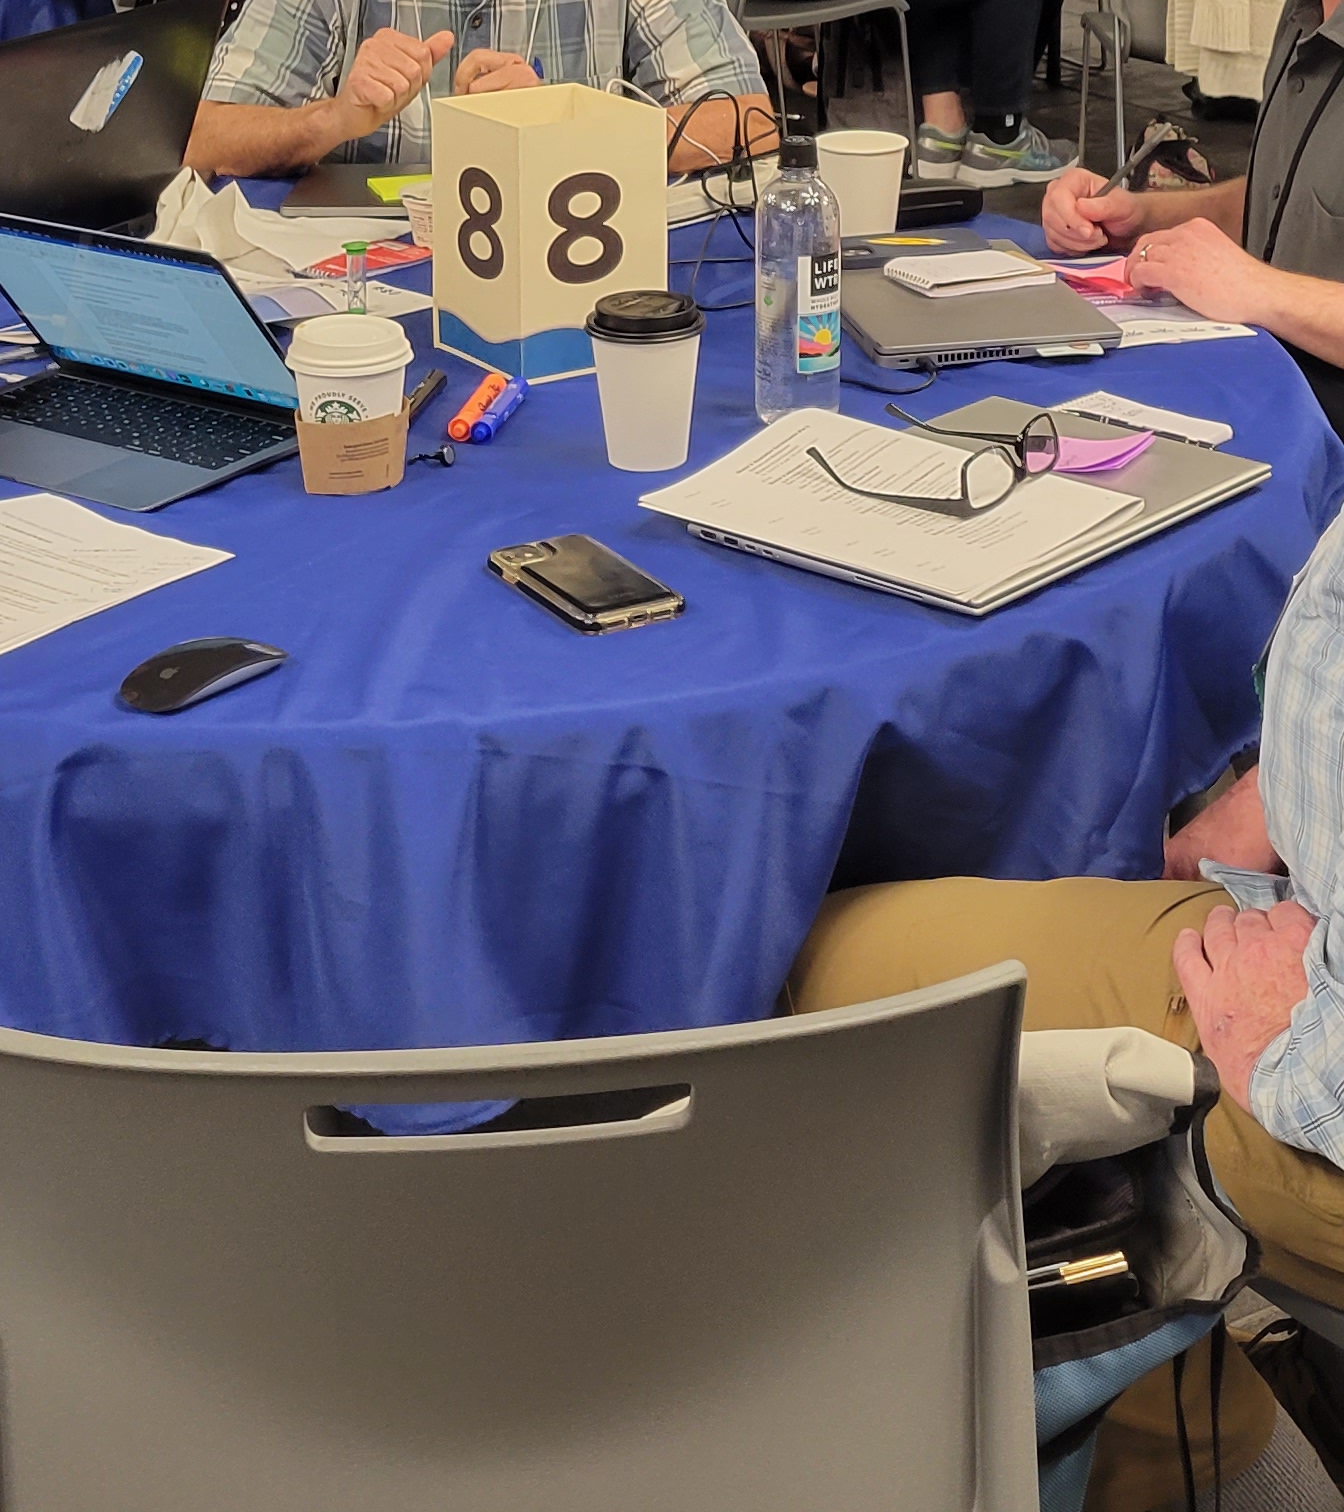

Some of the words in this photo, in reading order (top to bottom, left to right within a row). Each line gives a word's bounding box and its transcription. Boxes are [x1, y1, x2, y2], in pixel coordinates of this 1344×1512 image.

[458, 166, 504, 279] 8
[547, 171, 624, 284] 8
[309, 399, 316, 412] WE
[315, 391, 346, 404] PROUDLY
[348, 395, 368, 413] SERVE
